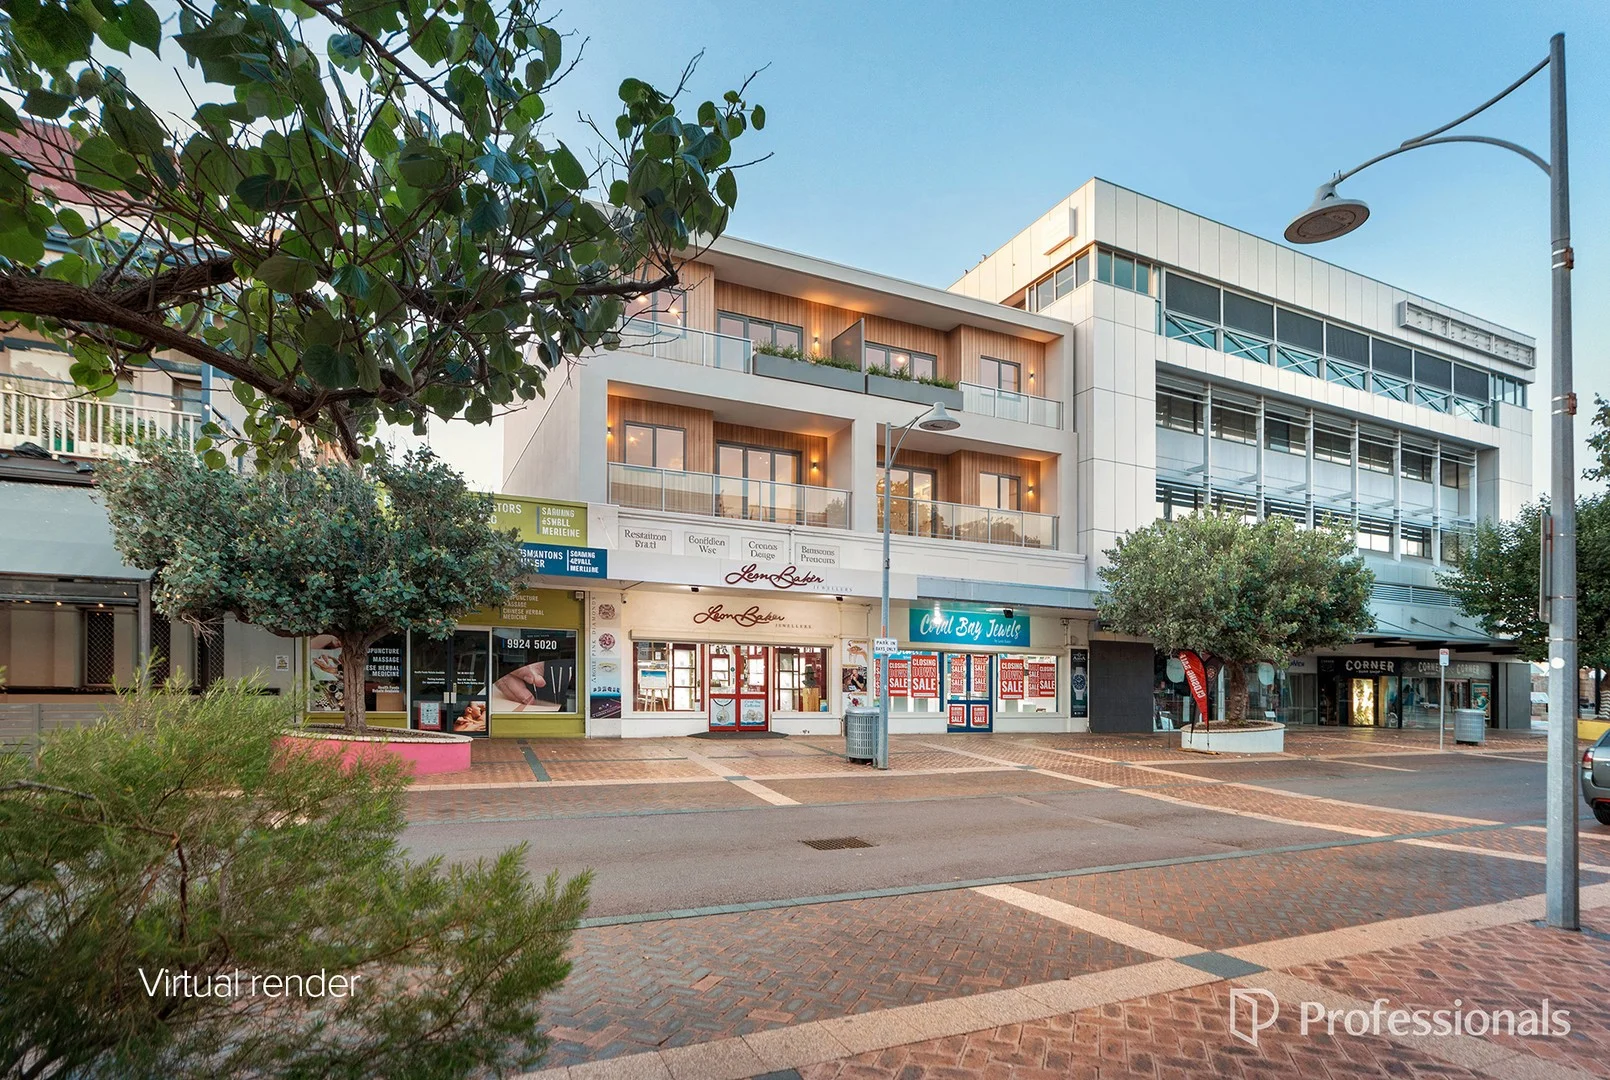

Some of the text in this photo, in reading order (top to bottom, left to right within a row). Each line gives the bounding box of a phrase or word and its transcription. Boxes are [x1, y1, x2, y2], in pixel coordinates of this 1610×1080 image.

[725, 563, 824, 589] Leon Baker
[694, 604, 785, 627] Leon Baker
[955, 617, 983, 641] Bay
[985, 619, 1022, 640] Jewels
[507, 639, 557, 650] 9924 5020
[912, 667, 937, 677] DOWN
[1345, 660, 1394, 673] CORNER
[1418, 661, 1441, 673] CORNE
[889, 678, 908, 688] SALE
[912, 678, 936, 690] SALE
[1001, 681, 1023, 692] SALE
[1040, 681, 1055, 689] SALE
